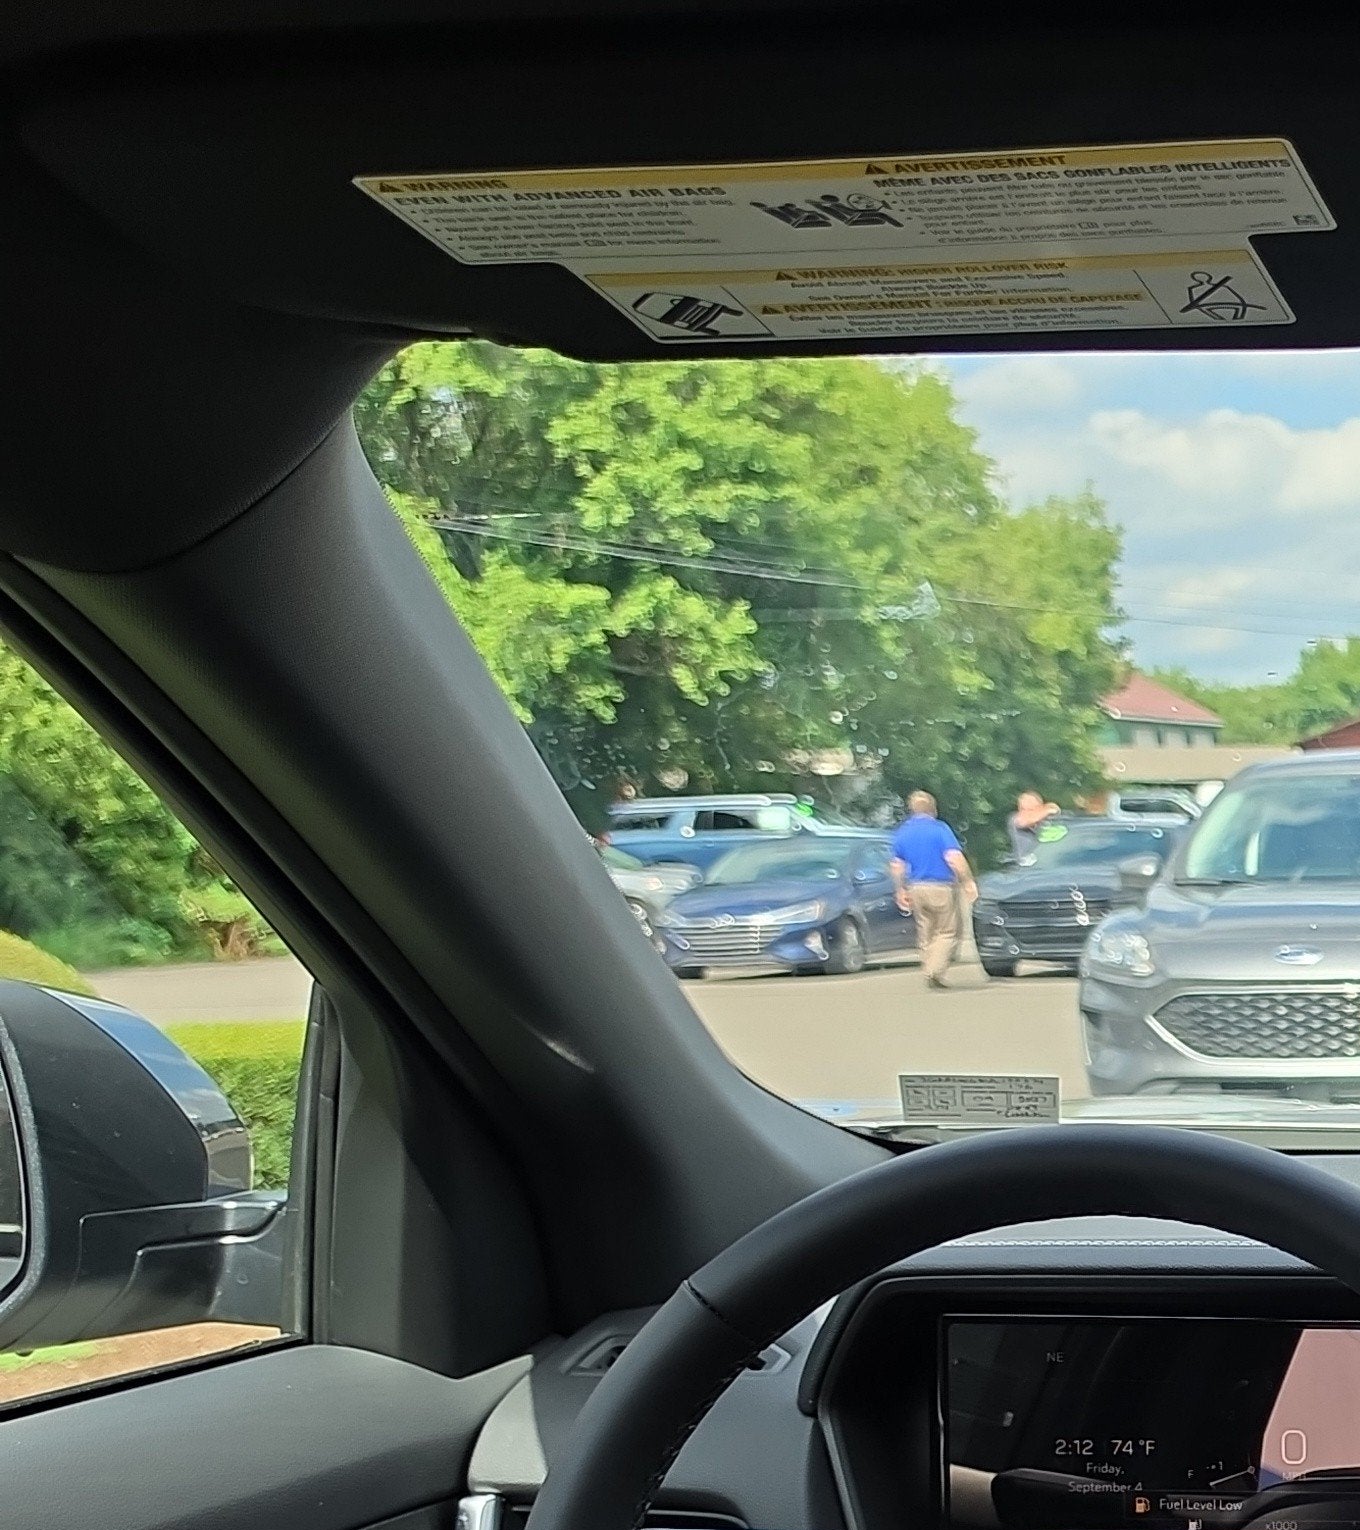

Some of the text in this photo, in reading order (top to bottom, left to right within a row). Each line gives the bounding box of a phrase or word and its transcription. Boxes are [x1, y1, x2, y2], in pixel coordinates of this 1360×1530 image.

[894, 155, 1067, 174] AVERTISSEMENT
[873, 159, 1291, 188] MÊME AVEC DES SACS GONFLABLES INTELLIGENTS
[403, 179, 509, 192] WARNING
[394, 186, 726, 206] EVEN WITH ADVANCED AIR BAGS
[1054, 1439, 1094, 1456] 2:12
[1111, 1439, 1133, 1456] 74
[1281, 1430, 1307, 1465] 0
[1086, 1462, 1125, 1476] Friday,
[1068, 1481, 1143, 1496] September 4
[1159, 1499, 1243, 1511] Fuel Level Low
